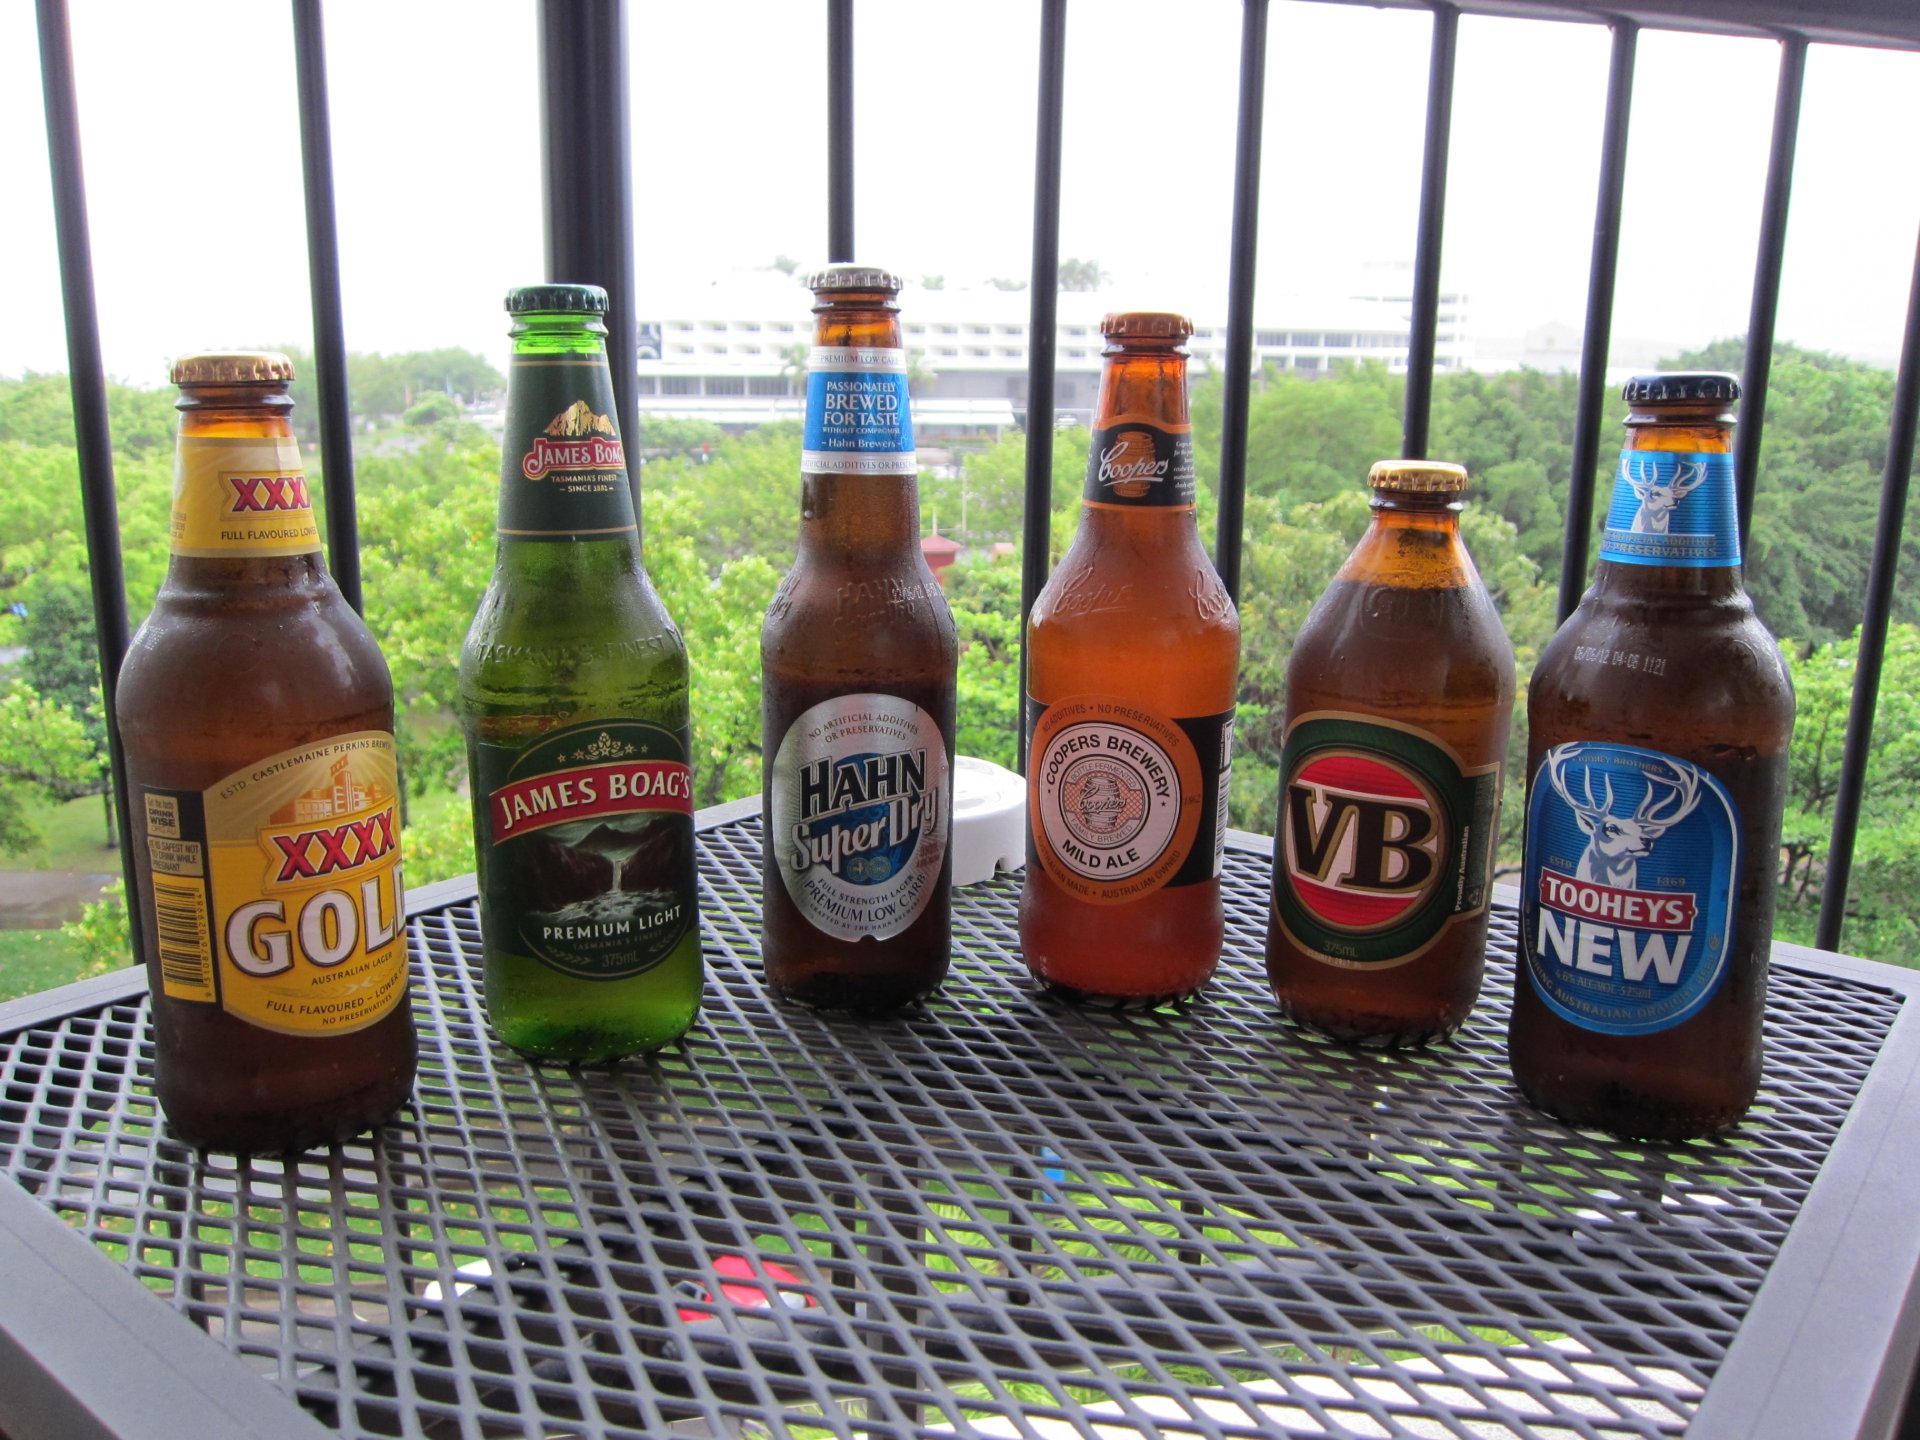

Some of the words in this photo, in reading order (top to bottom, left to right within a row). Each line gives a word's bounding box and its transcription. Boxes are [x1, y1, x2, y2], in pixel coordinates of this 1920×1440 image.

[820, 354, 858, 364] PREMIUM
[860, 355, 880, 364] LOW
[825, 393, 897, 411] BREWED
[826, 381, 896, 392] PASSIONATELY
[822, 426, 854, 434] WITHOUT
[856, 427, 900, 435] COMPROMISE
[823, 411, 856, 426] FOR
[858, 412, 900, 426] TASTE
[526, 444, 591, 474] JAMES
[828, 438, 855, 448] Hahn
[858, 438, 896, 448] Brewers
[551, 474, 596, 483] TASMANIA'S
[833, 461, 876, 470] ADDITIVES
[878, 461, 890, 469] OR
[1098, 441, 1169, 484] Coopers
[230, 476, 311, 512] XXX
[567, 484, 592, 493] SINCE
[221, 529, 245, 541] FULL
[247, 528, 299, 540] FLAVOURED
[808, 728, 822, 740] NO
[823, 713, 873, 732] ARTIFICIAL
[876, 713, 919, 735] ADDITIVES
[825, 732, 839, 743] OR
[840, 724, 907, 741] PRESERVATIVES
[1050, 703, 1087, 723] ADDITIVES
[1097, 703, 1112, 714] NO
[1113, 705, 1180, 747] PRESERVATIVES
[220, 780, 247, 800] ESTD
[252, 747, 330, 782] CASTLEMAINE
[333, 740, 370, 754] PERKINS
[1045, 734, 1101, 786] COOPERS
[1105, 735, 1171, 799] BREWERY
[1094, 762, 1137, 788] FERMENTED
[500, 776, 598, 831] JAMES
[608, 770, 690, 800] BOAG'S
[799, 748, 928, 822] HAHN
[148, 808, 175, 818] DRINK
[149, 816, 177, 828] WISE
[273, 807, 396, 882] XXXX
[790, 814, 889, 875] Super
[888, 786, 938, 848] Dry
[1097, 824, 1133, 843] BREWED
[1288, 782, 1439, 894] VB
[162, 841, 184, 853] SAFEST
[185, 844, 199, 854] NOT
[176, 853, 198, 864] WHILE
[1062, 838, 1101, 869] MILD
[1106, 847, 1141, 870] ALE
[1459, 825, 1470, 874] Australian
[818, 877, 837, 897] FULL
[839, 892, 889, 905] STRENGTH
[890, 873, 915, 898] LAGER
[1066, 877, 1089, 896] MADE
[1101, 876, 1156, 899] AUSTRALIAN
[1155, 849, 1181, 879] OWNED
[804, 880, 863, 922] PREMIUM
[867, 902, 897, 922] LOW
[899, 873, 928, 908] CARB
[1454, 875, 1466, 912] Proudly
[1546, 876, 1685, 925] TOOHEYS
[542, 920, 631, 940] PREMIUM
[639, 904, 682, 931] LIGHT
[810, 903, 839, 926] CRAFTED
[854, 924, 870, 932] THE
[871, 921, 893, 931] HAHN
[1537, 906, 1693, 985] NEW
[311, 960, 371, 986] AUSTRALIAN
[371, 951, 393, 969] LAGER
[266, 999, 296, 1014] FULL
[299, 997, 365, 1015] FLAVOURED
[375, 971, 400, 999] LOWER
[1553, 988, 1632, 1019] AUSTRALIAN
[321, 1016, 336, 1026] NO
[339, 994, 393, 1023] PRESERVATIVES
